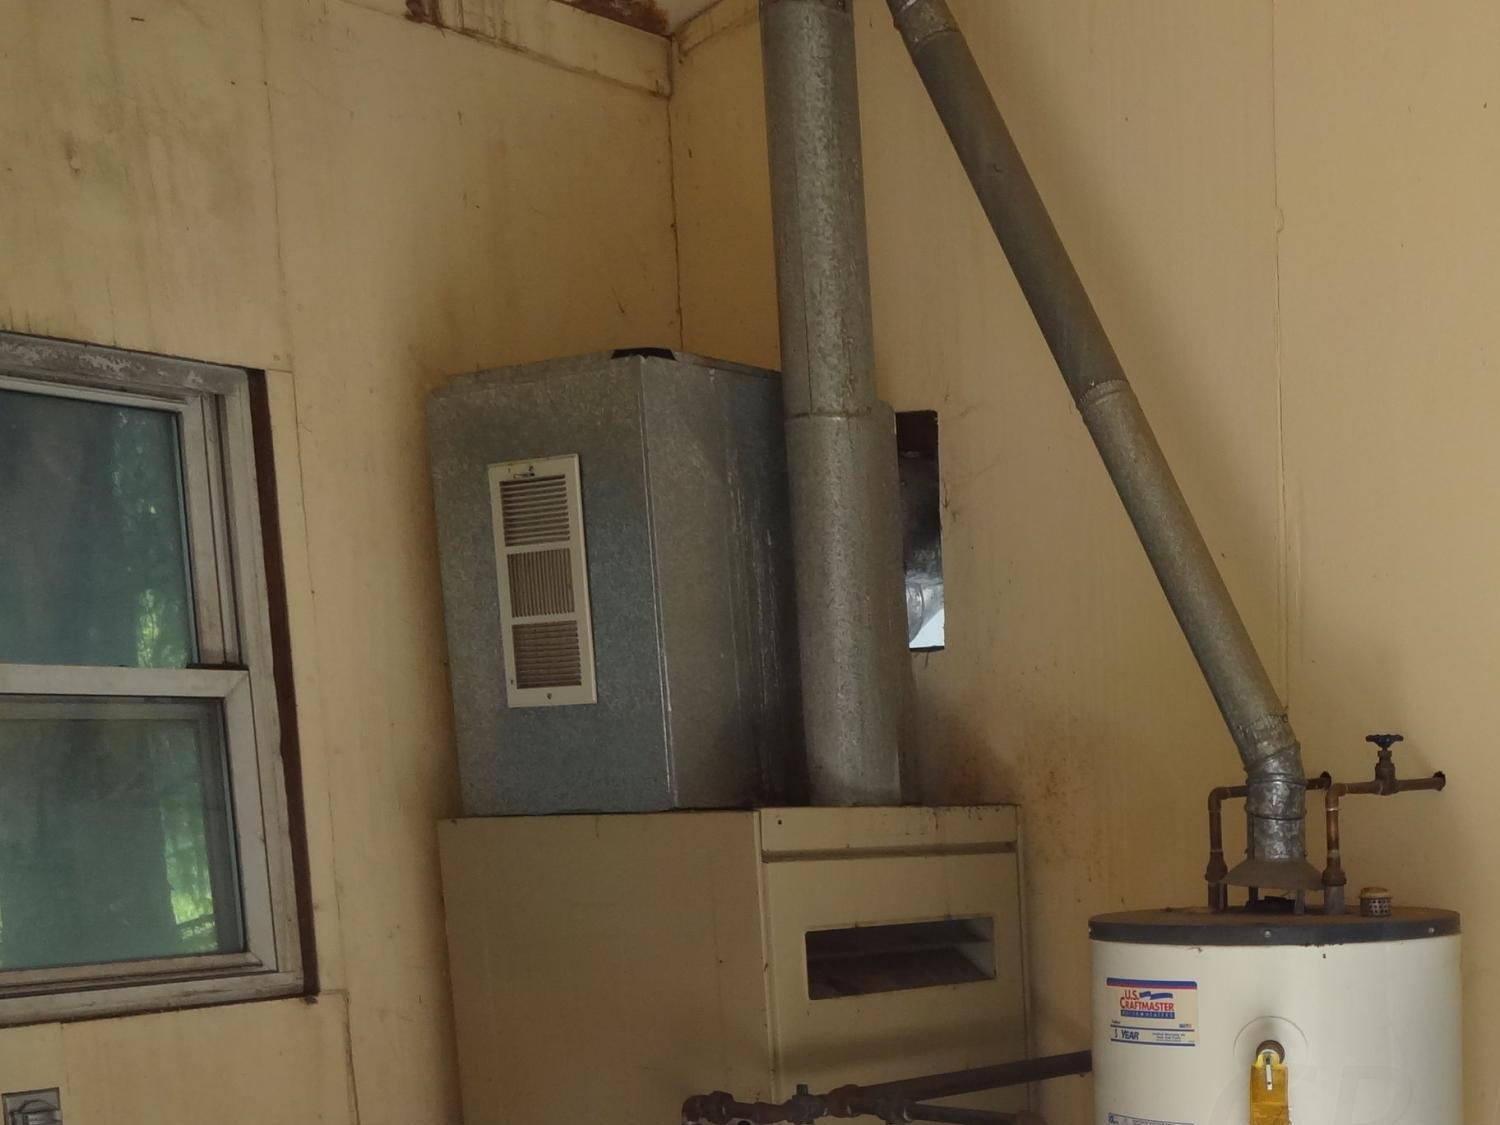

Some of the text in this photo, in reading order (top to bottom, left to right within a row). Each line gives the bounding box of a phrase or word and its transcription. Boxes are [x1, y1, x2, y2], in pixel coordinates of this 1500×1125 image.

[1124, 989, 1140, 1001] U.S.
[1119, 996, 1175, 1012] CRAFTMASTER
[1121, 1029, 1140, 1041] YEAR
